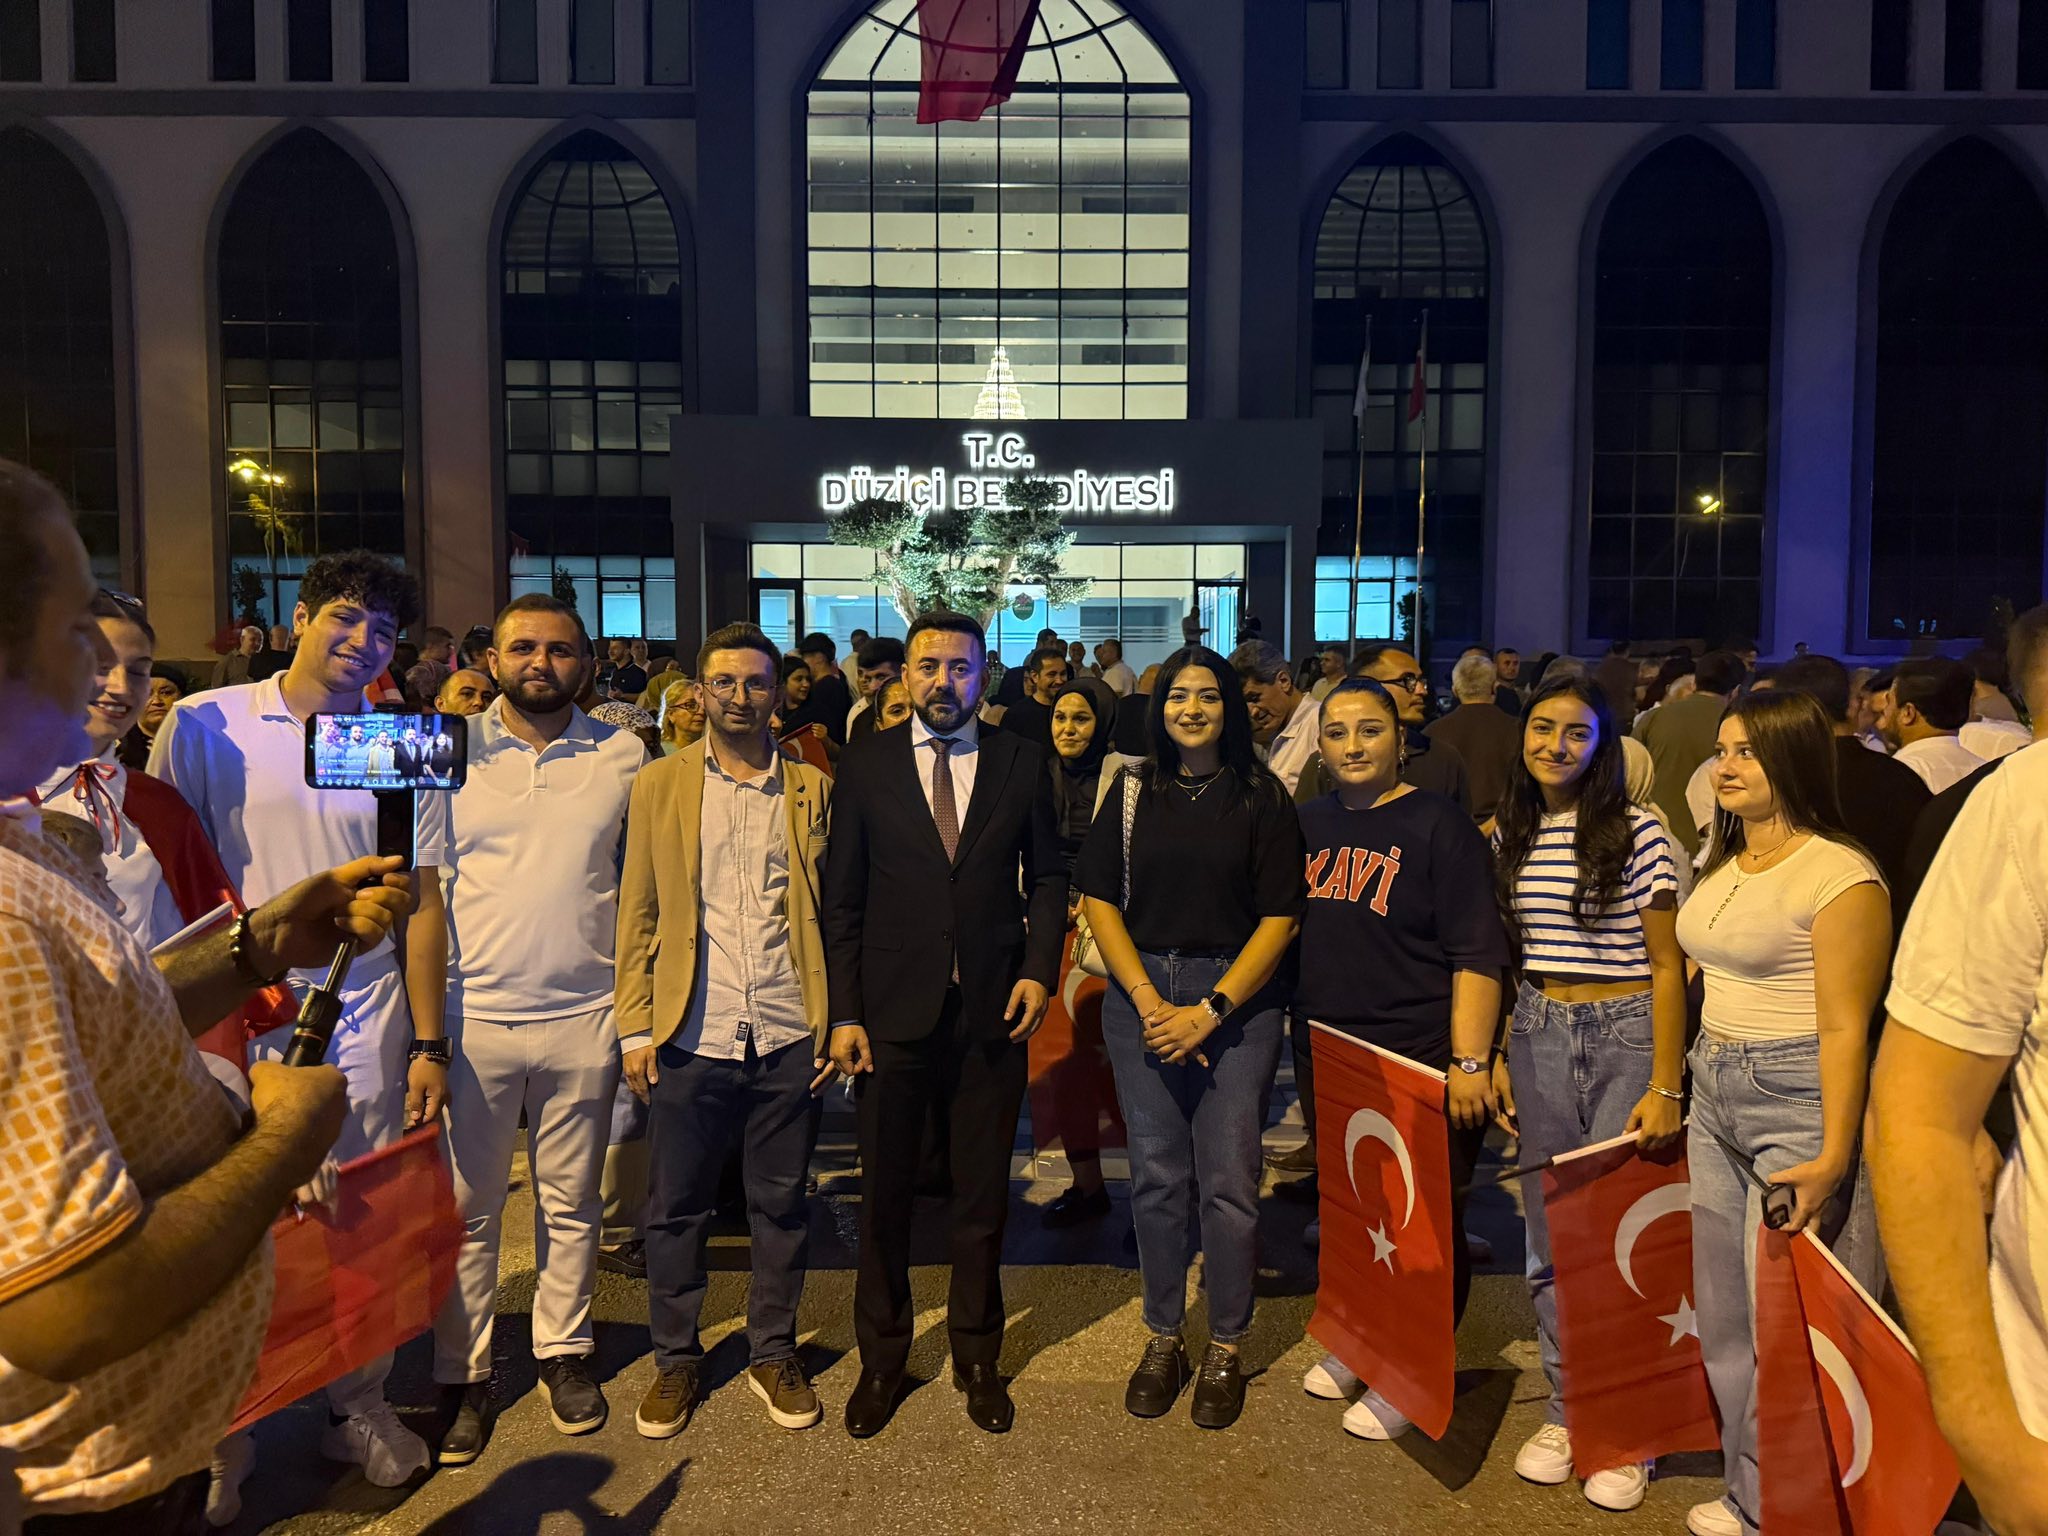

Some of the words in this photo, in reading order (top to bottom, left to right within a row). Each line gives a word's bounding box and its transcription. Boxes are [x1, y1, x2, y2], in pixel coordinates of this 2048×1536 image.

[965, 435, 1033, 465] T.C.
[823, 467, 944, 512] DÜZİÇİ
[955, 469, 1172, 509] BEDİYESİ
